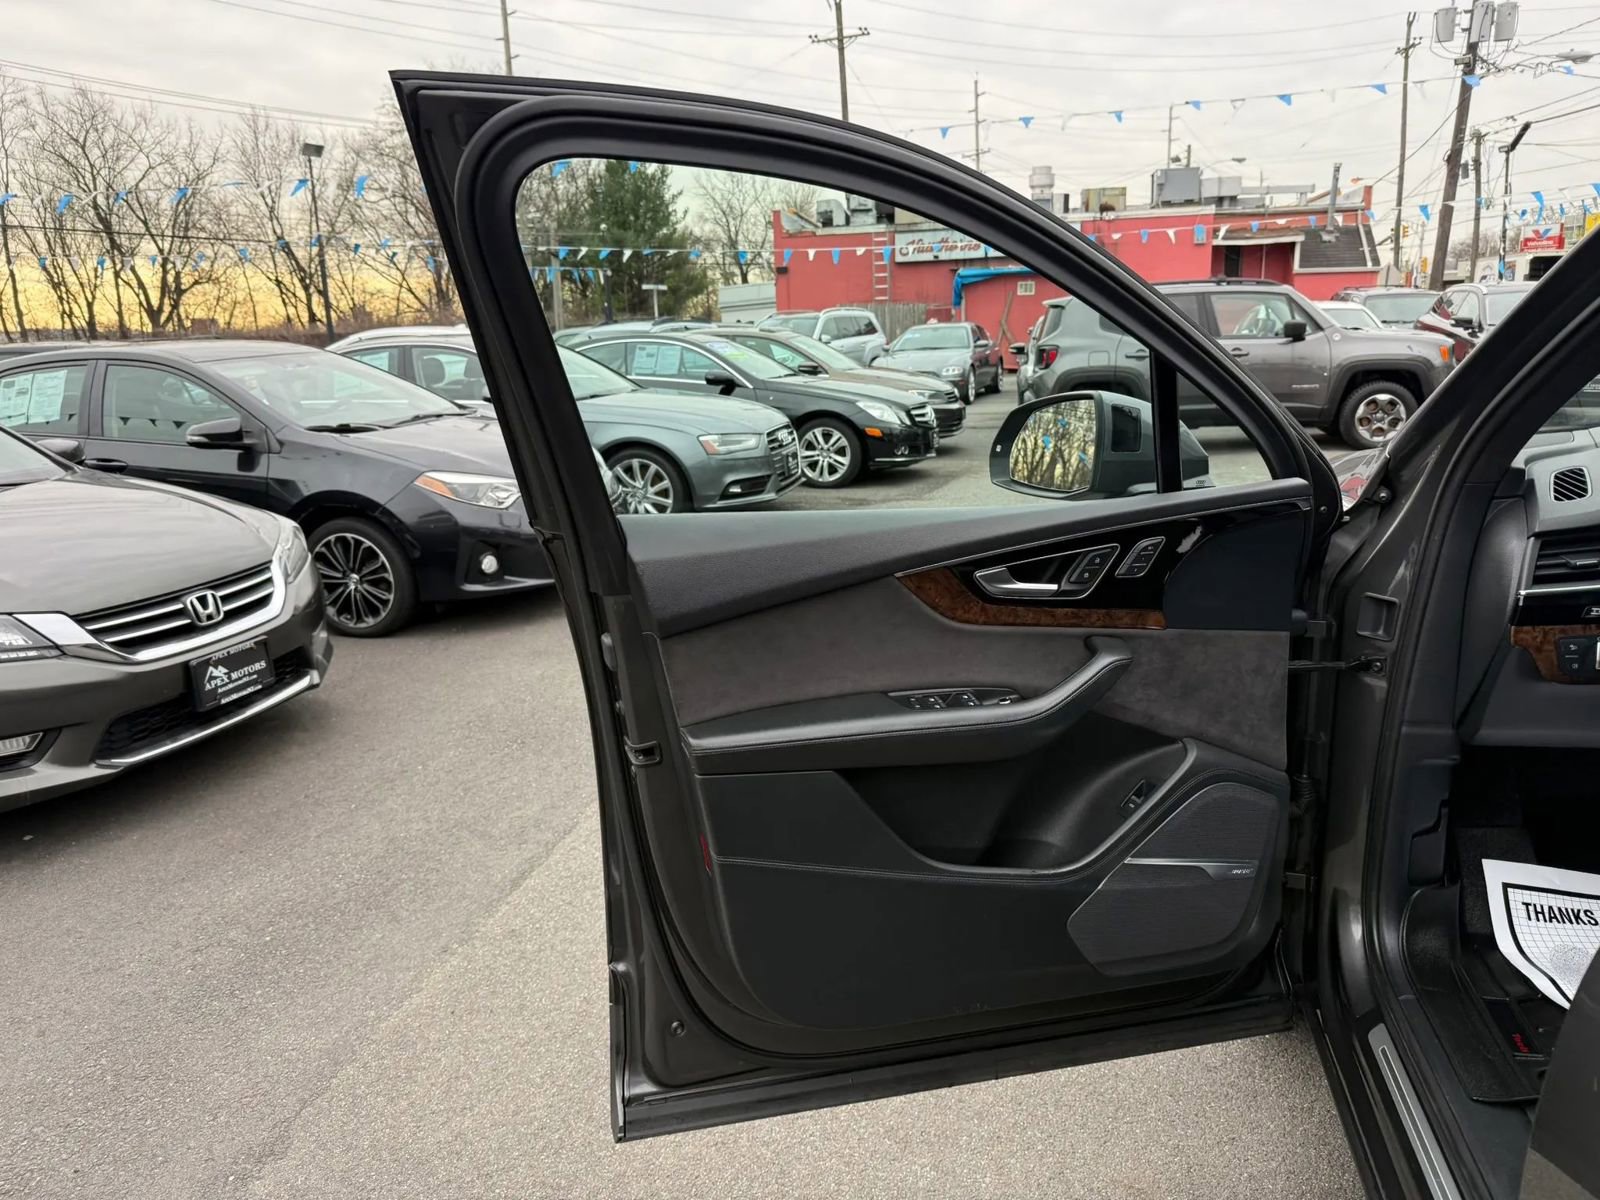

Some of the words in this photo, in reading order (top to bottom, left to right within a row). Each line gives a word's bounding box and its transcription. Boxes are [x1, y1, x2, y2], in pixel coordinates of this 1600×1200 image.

[204, 674, 230, 691] APEX
[230, 660, 267, 681] MOTORS
[1521, 902, 1599, 926] THANKS
